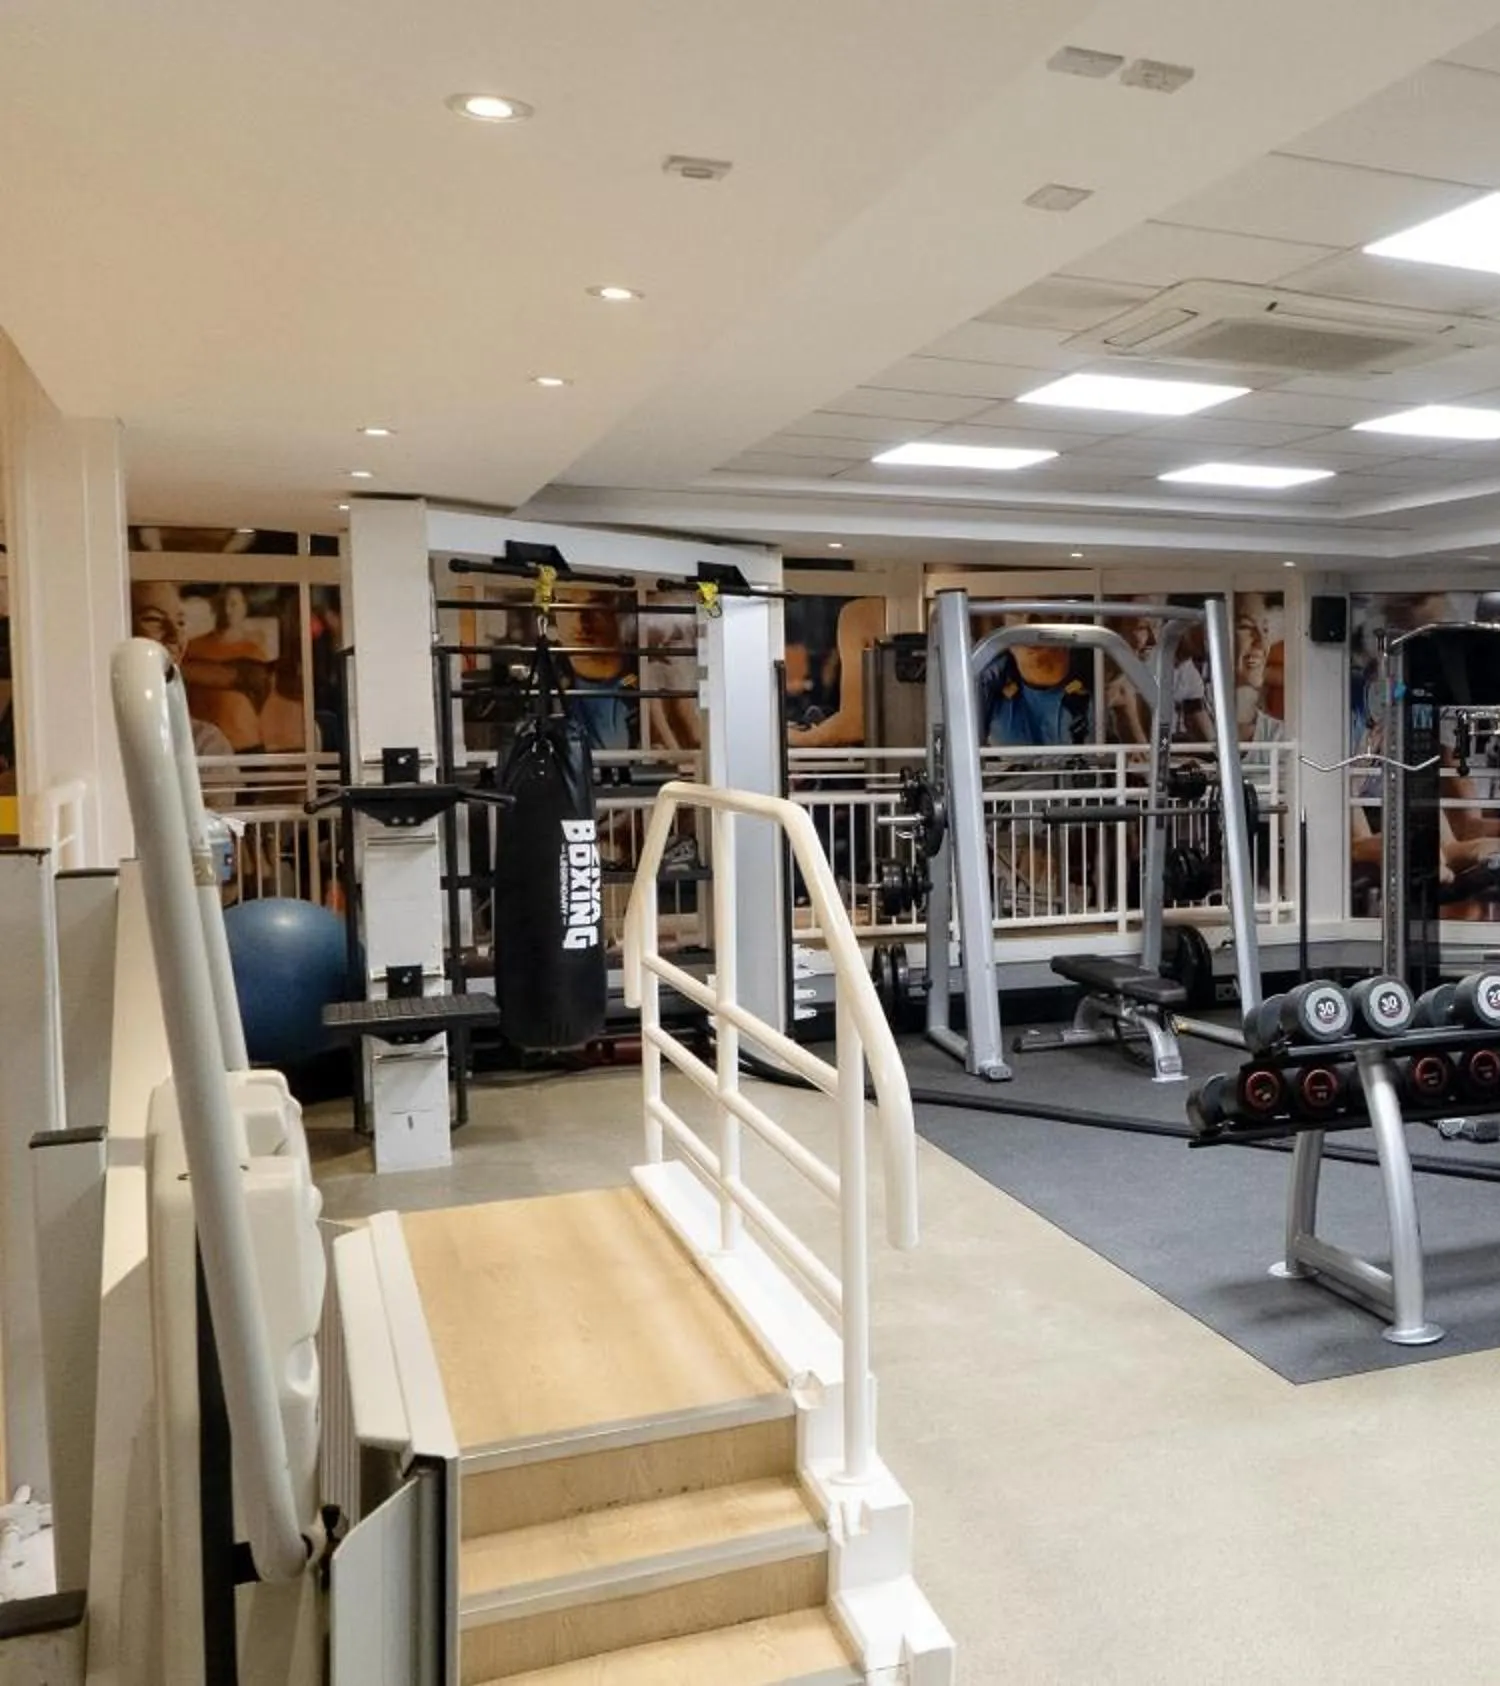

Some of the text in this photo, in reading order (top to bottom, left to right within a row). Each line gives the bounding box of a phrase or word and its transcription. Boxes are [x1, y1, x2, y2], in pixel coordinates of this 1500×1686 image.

[560, 820, 598, 949] BOXING
[1318, 1001, 1336, 1016] 30
[1380, 995, 1398, 1012] 30
